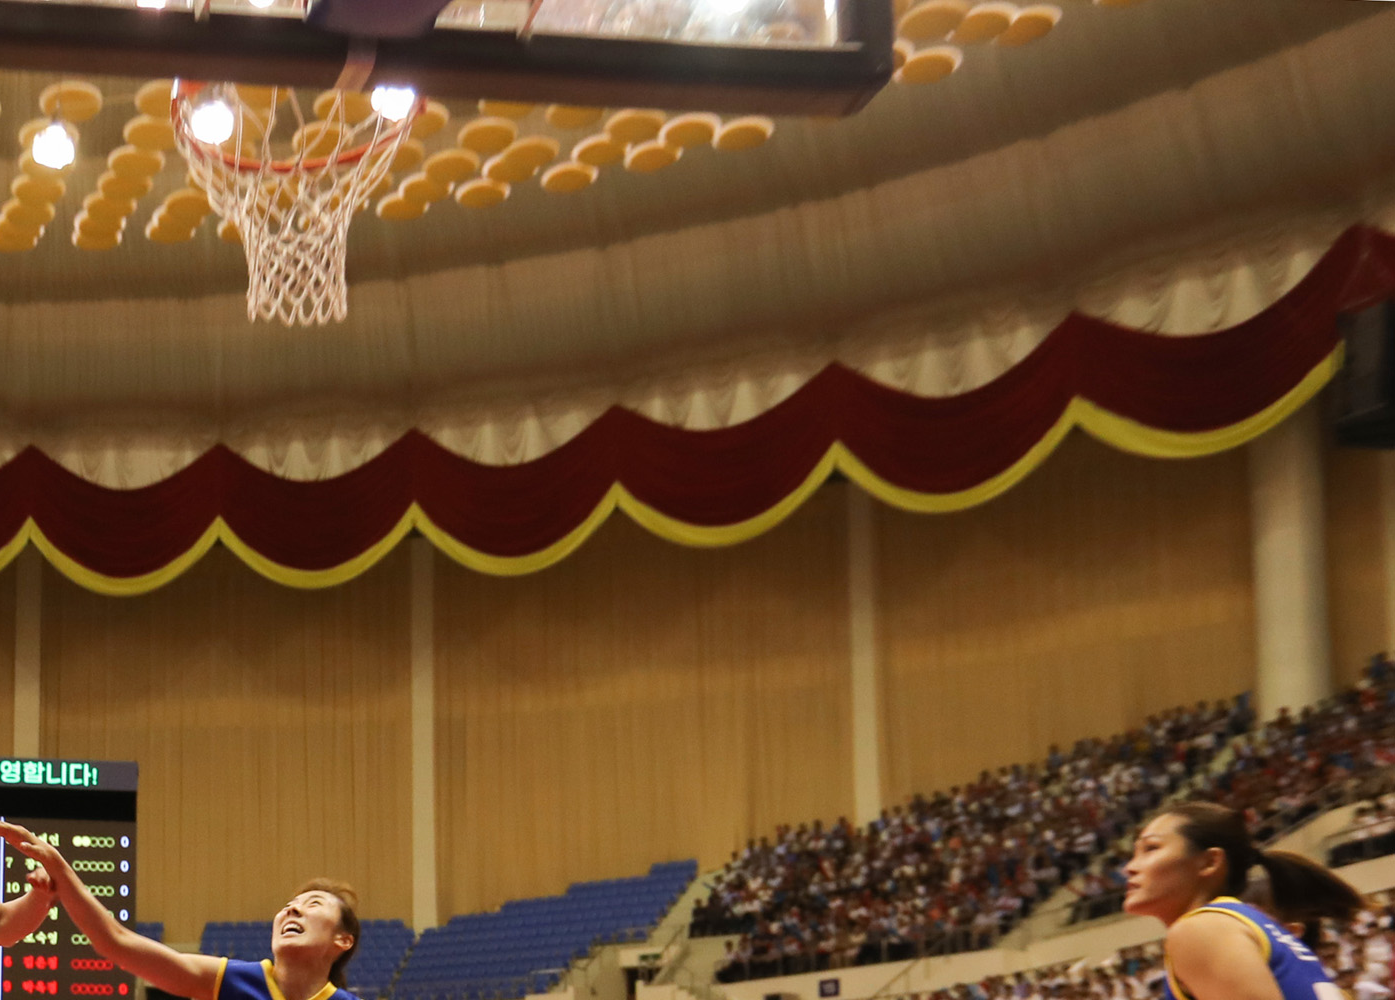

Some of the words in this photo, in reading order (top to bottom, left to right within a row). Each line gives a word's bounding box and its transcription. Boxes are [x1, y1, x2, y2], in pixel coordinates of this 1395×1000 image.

[120, 835, 130, 848] 0
[4, 857, 14, 869] 7
[119, 860, 130, 873] 0
[5, 881, 21, 894] 10
[119, 884, 130, 897] 0
[119, 909, 129, 922] 0
